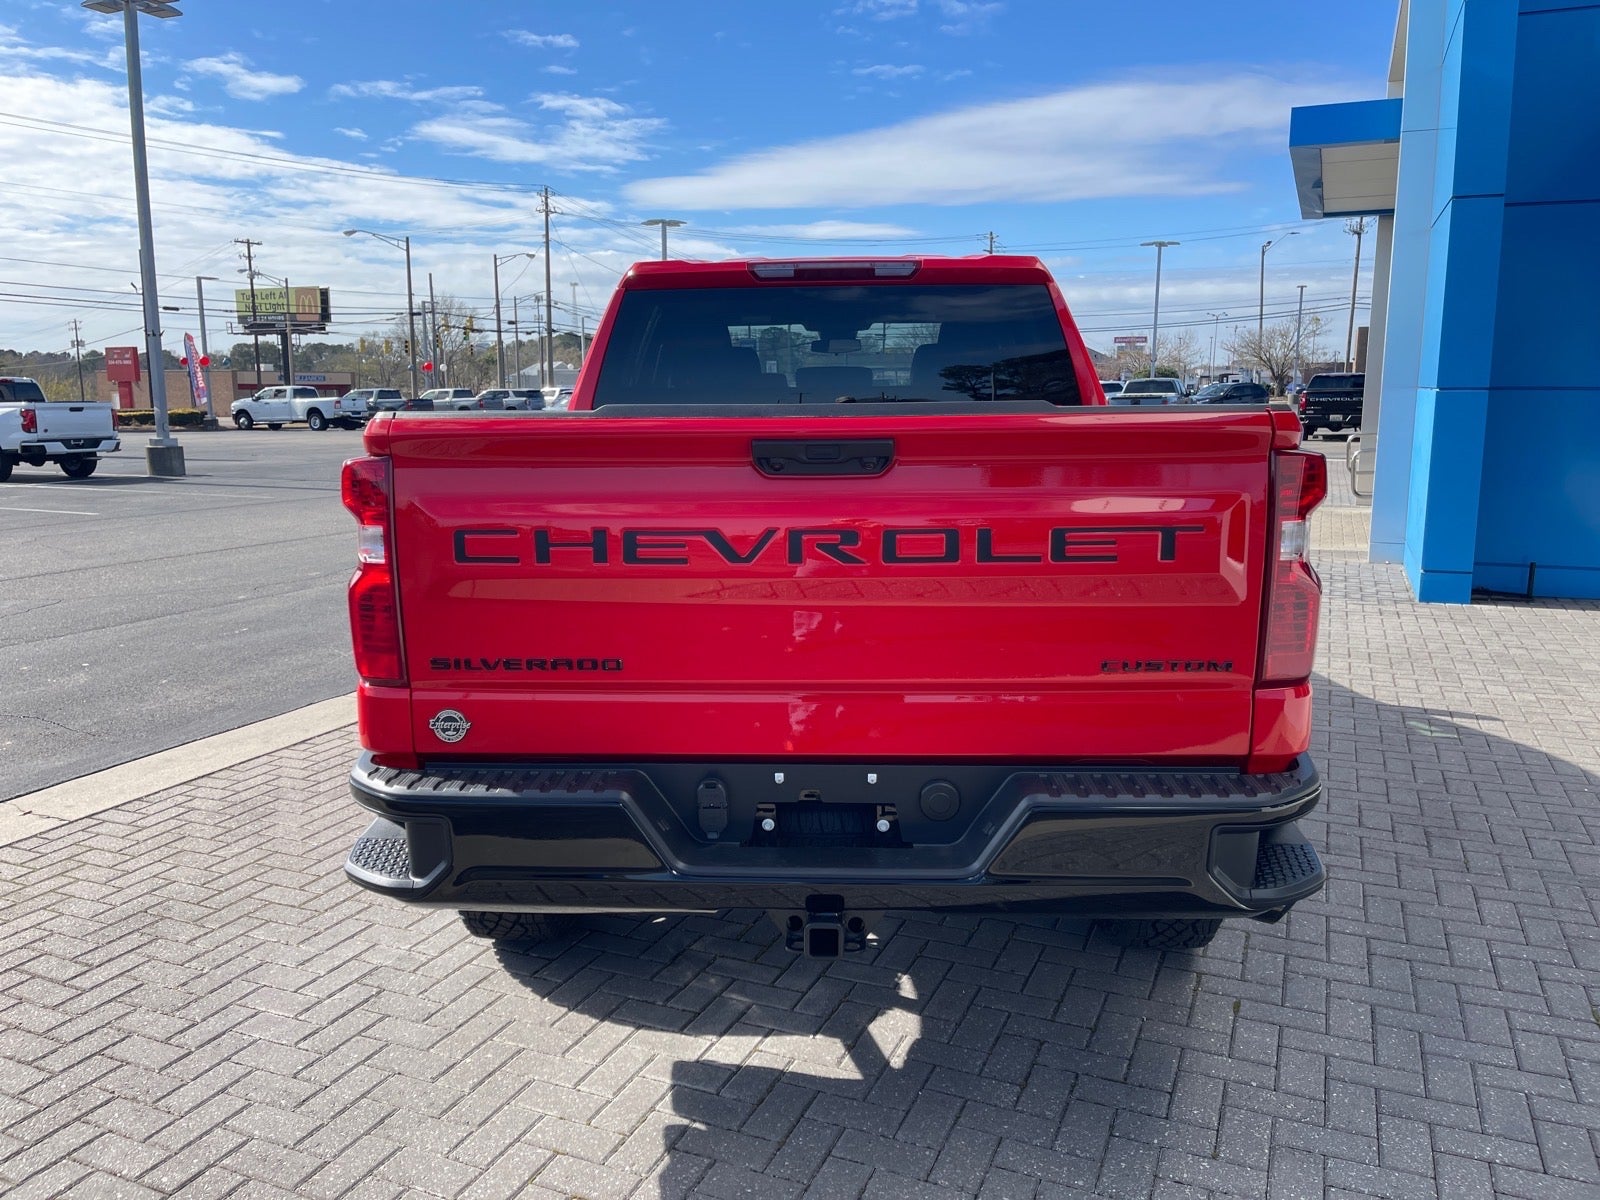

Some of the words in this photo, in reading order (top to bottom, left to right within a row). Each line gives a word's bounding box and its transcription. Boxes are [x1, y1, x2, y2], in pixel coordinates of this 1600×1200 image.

[240, 292, 258, 301] Tun
[260, 291, 276, 300] Left
[264, 302, 285, 312] Light
[452, 525, 1206, 567] CHEVROLET
[429, 656, 624, 671] SILVERADO
[1100, 659, 1233, 673] CUSTOM
[428, 719, 472, 732] Enterprise
